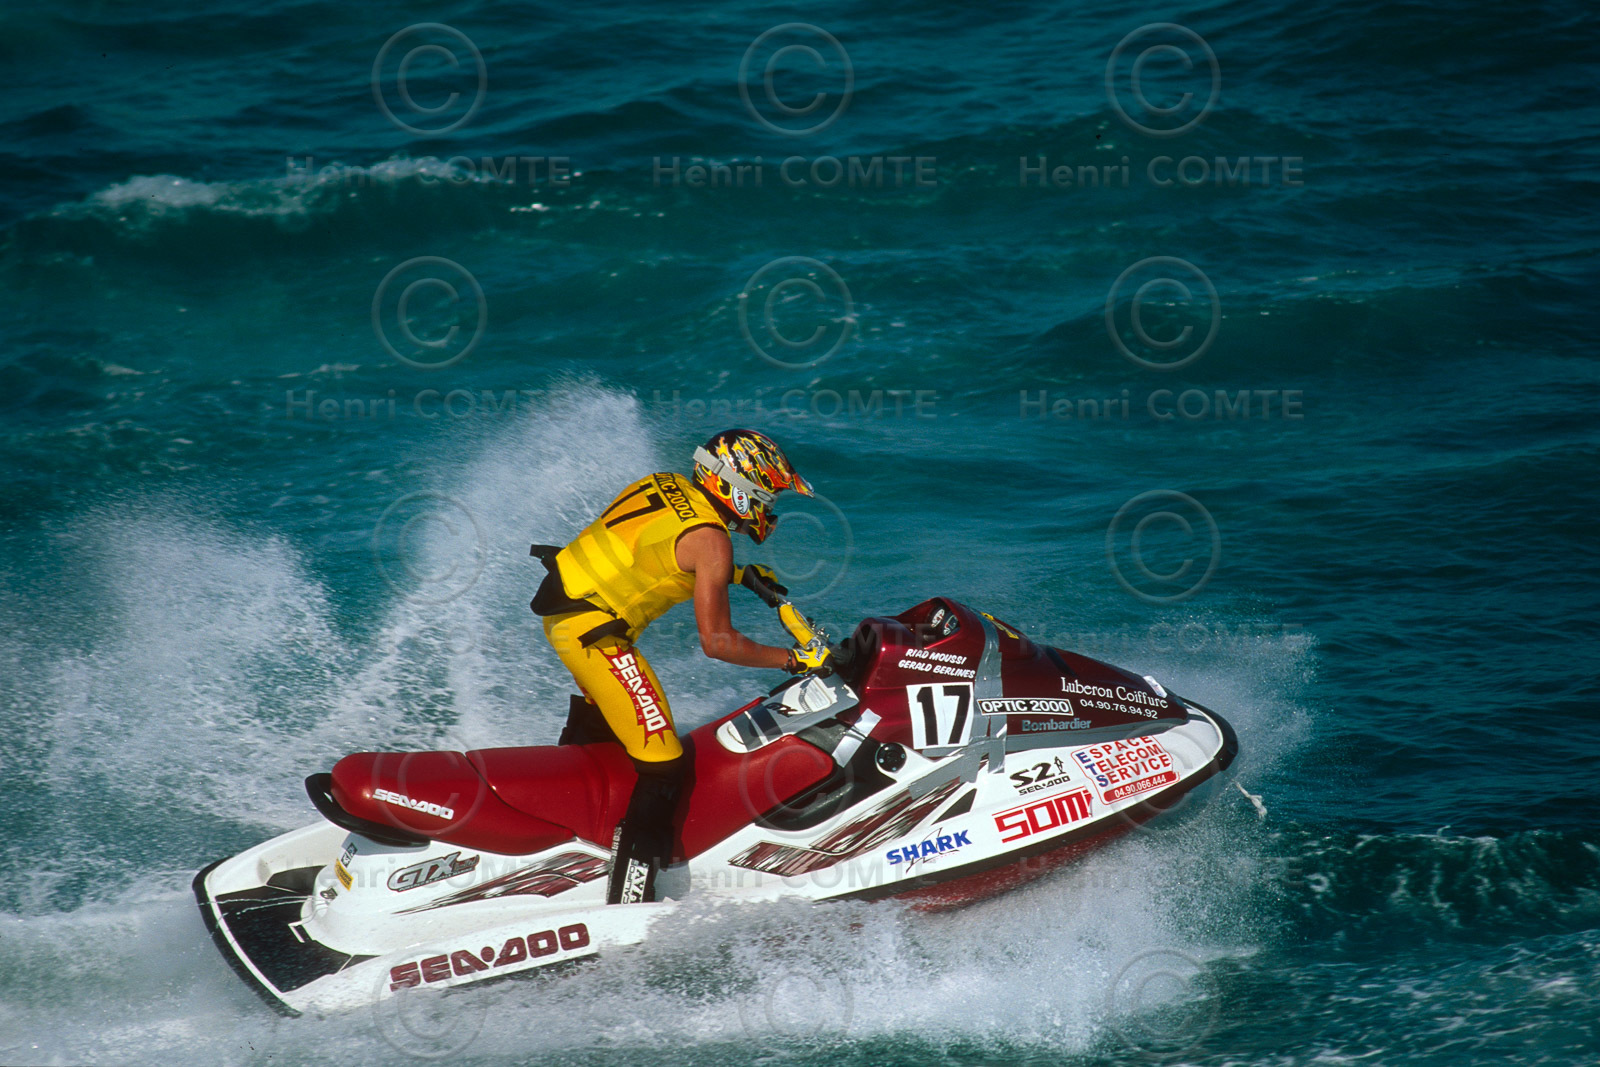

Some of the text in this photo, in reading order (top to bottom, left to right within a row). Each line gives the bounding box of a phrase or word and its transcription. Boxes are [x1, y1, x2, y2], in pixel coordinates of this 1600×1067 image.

[600, 482, 667, 529] 17
[666, 490, 695, 518] 2000
[898, 659, 976, 679] GERALD BERLINES
[905, 648, 967, 665] RIAD MOUSSI
[981, 699, 1070, 713] OPTIC 2000
[1061, 676, 1113, 699] Luberon
[1116, 686, 1169, 709] Coiffure
[916, 685, 971, 746] 17
[1022, 717, 1092, 732] Bombardier
[1080, 699, 1158, 719] 04.90.76.94.92
[1084, 744, 1163, 776] TELECOM
[1096, 754, 1172, 788] SERVICE
[886, 829, 973, 865] SHARK
[388, 852, 460, 890] GTX
